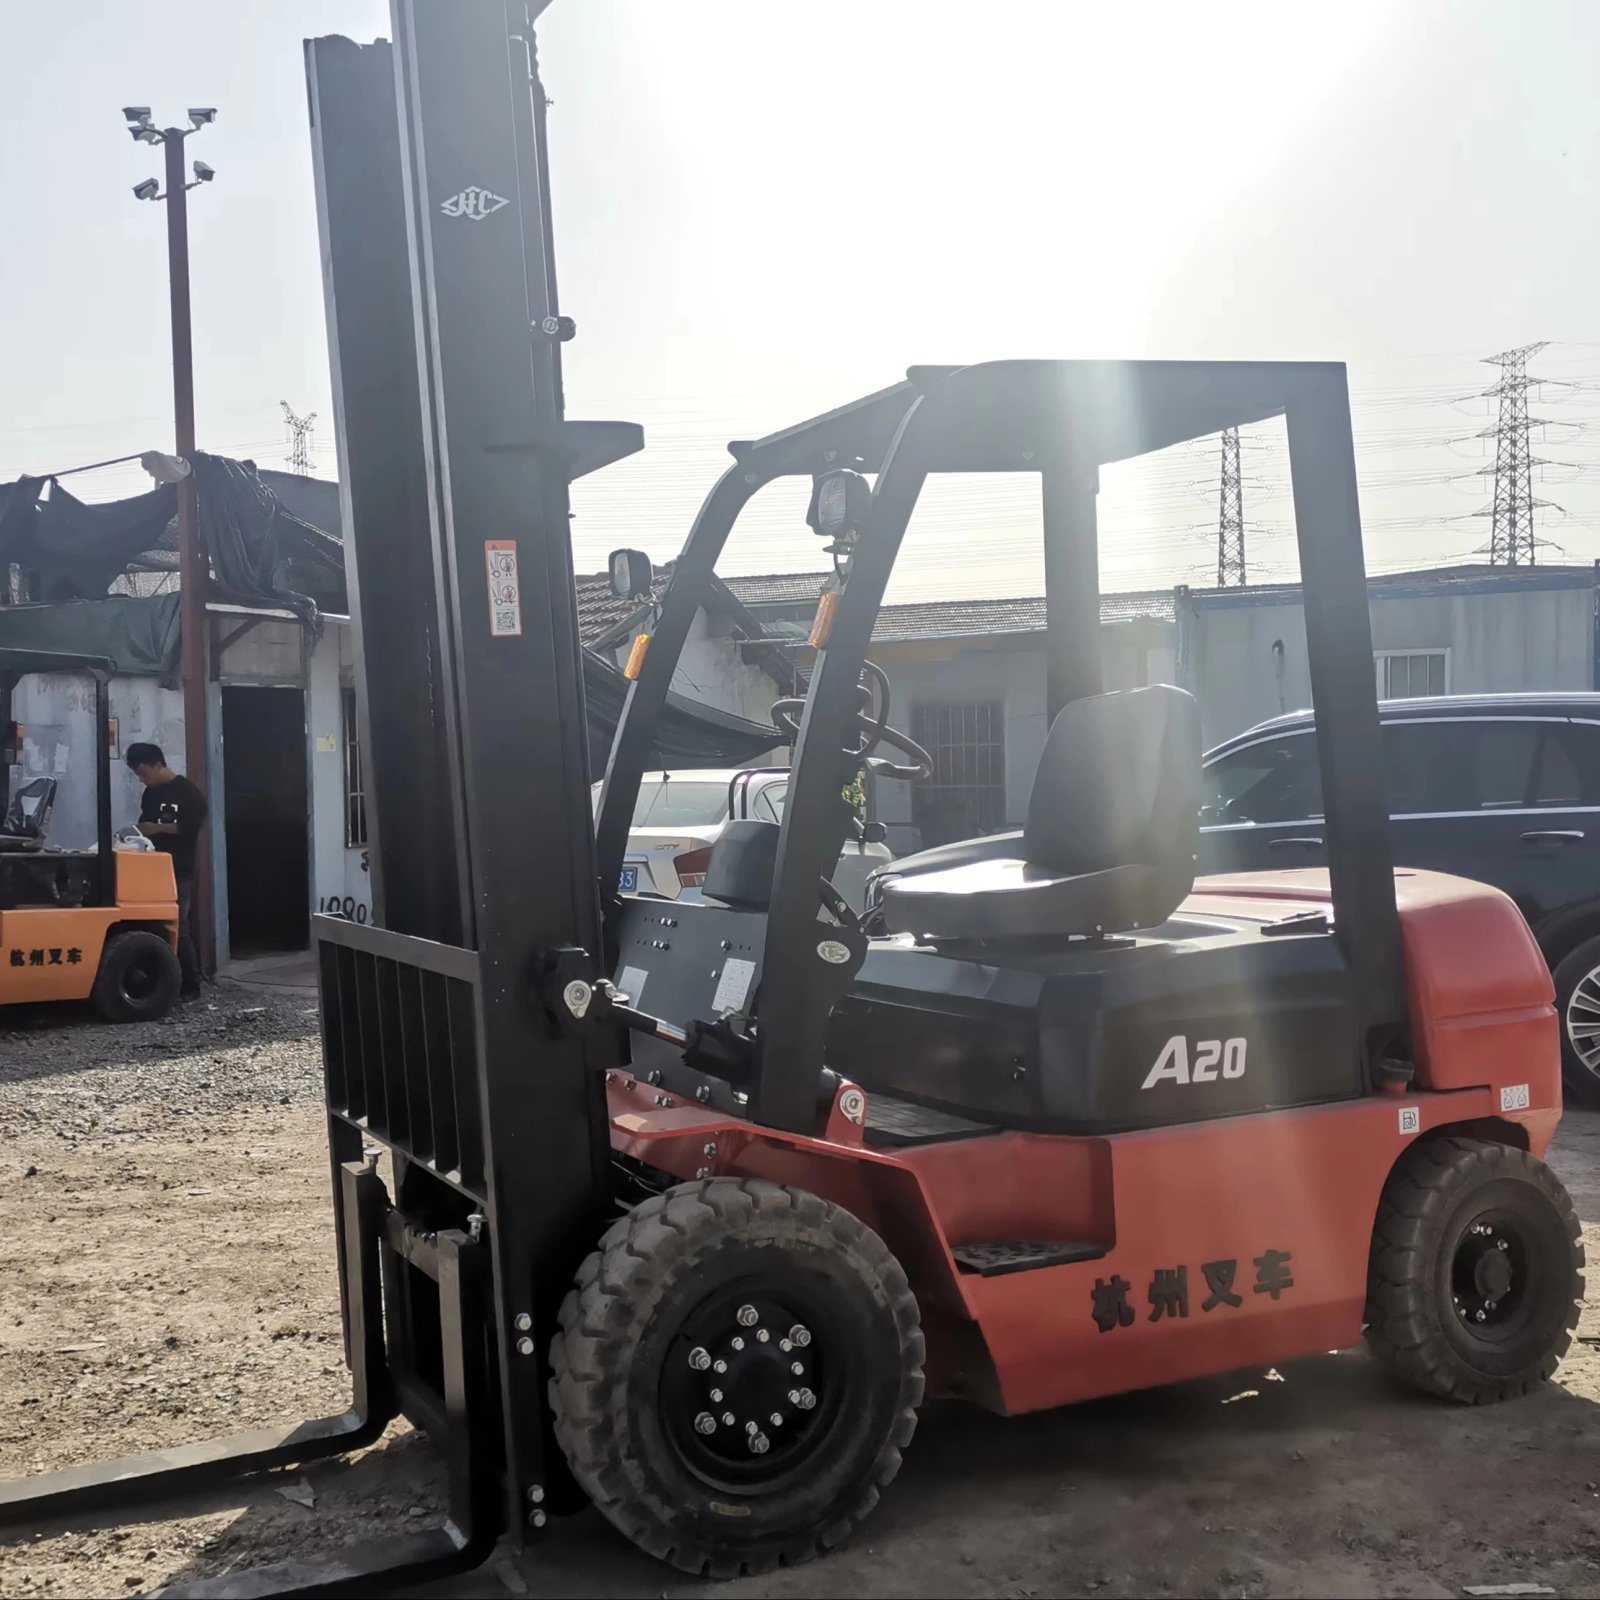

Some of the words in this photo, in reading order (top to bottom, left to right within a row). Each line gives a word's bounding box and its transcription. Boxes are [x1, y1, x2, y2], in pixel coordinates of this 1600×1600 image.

[1141, 1035, 1247, 1089] A20
[1091, 1250, 1294, 1333] 杭州叉车
